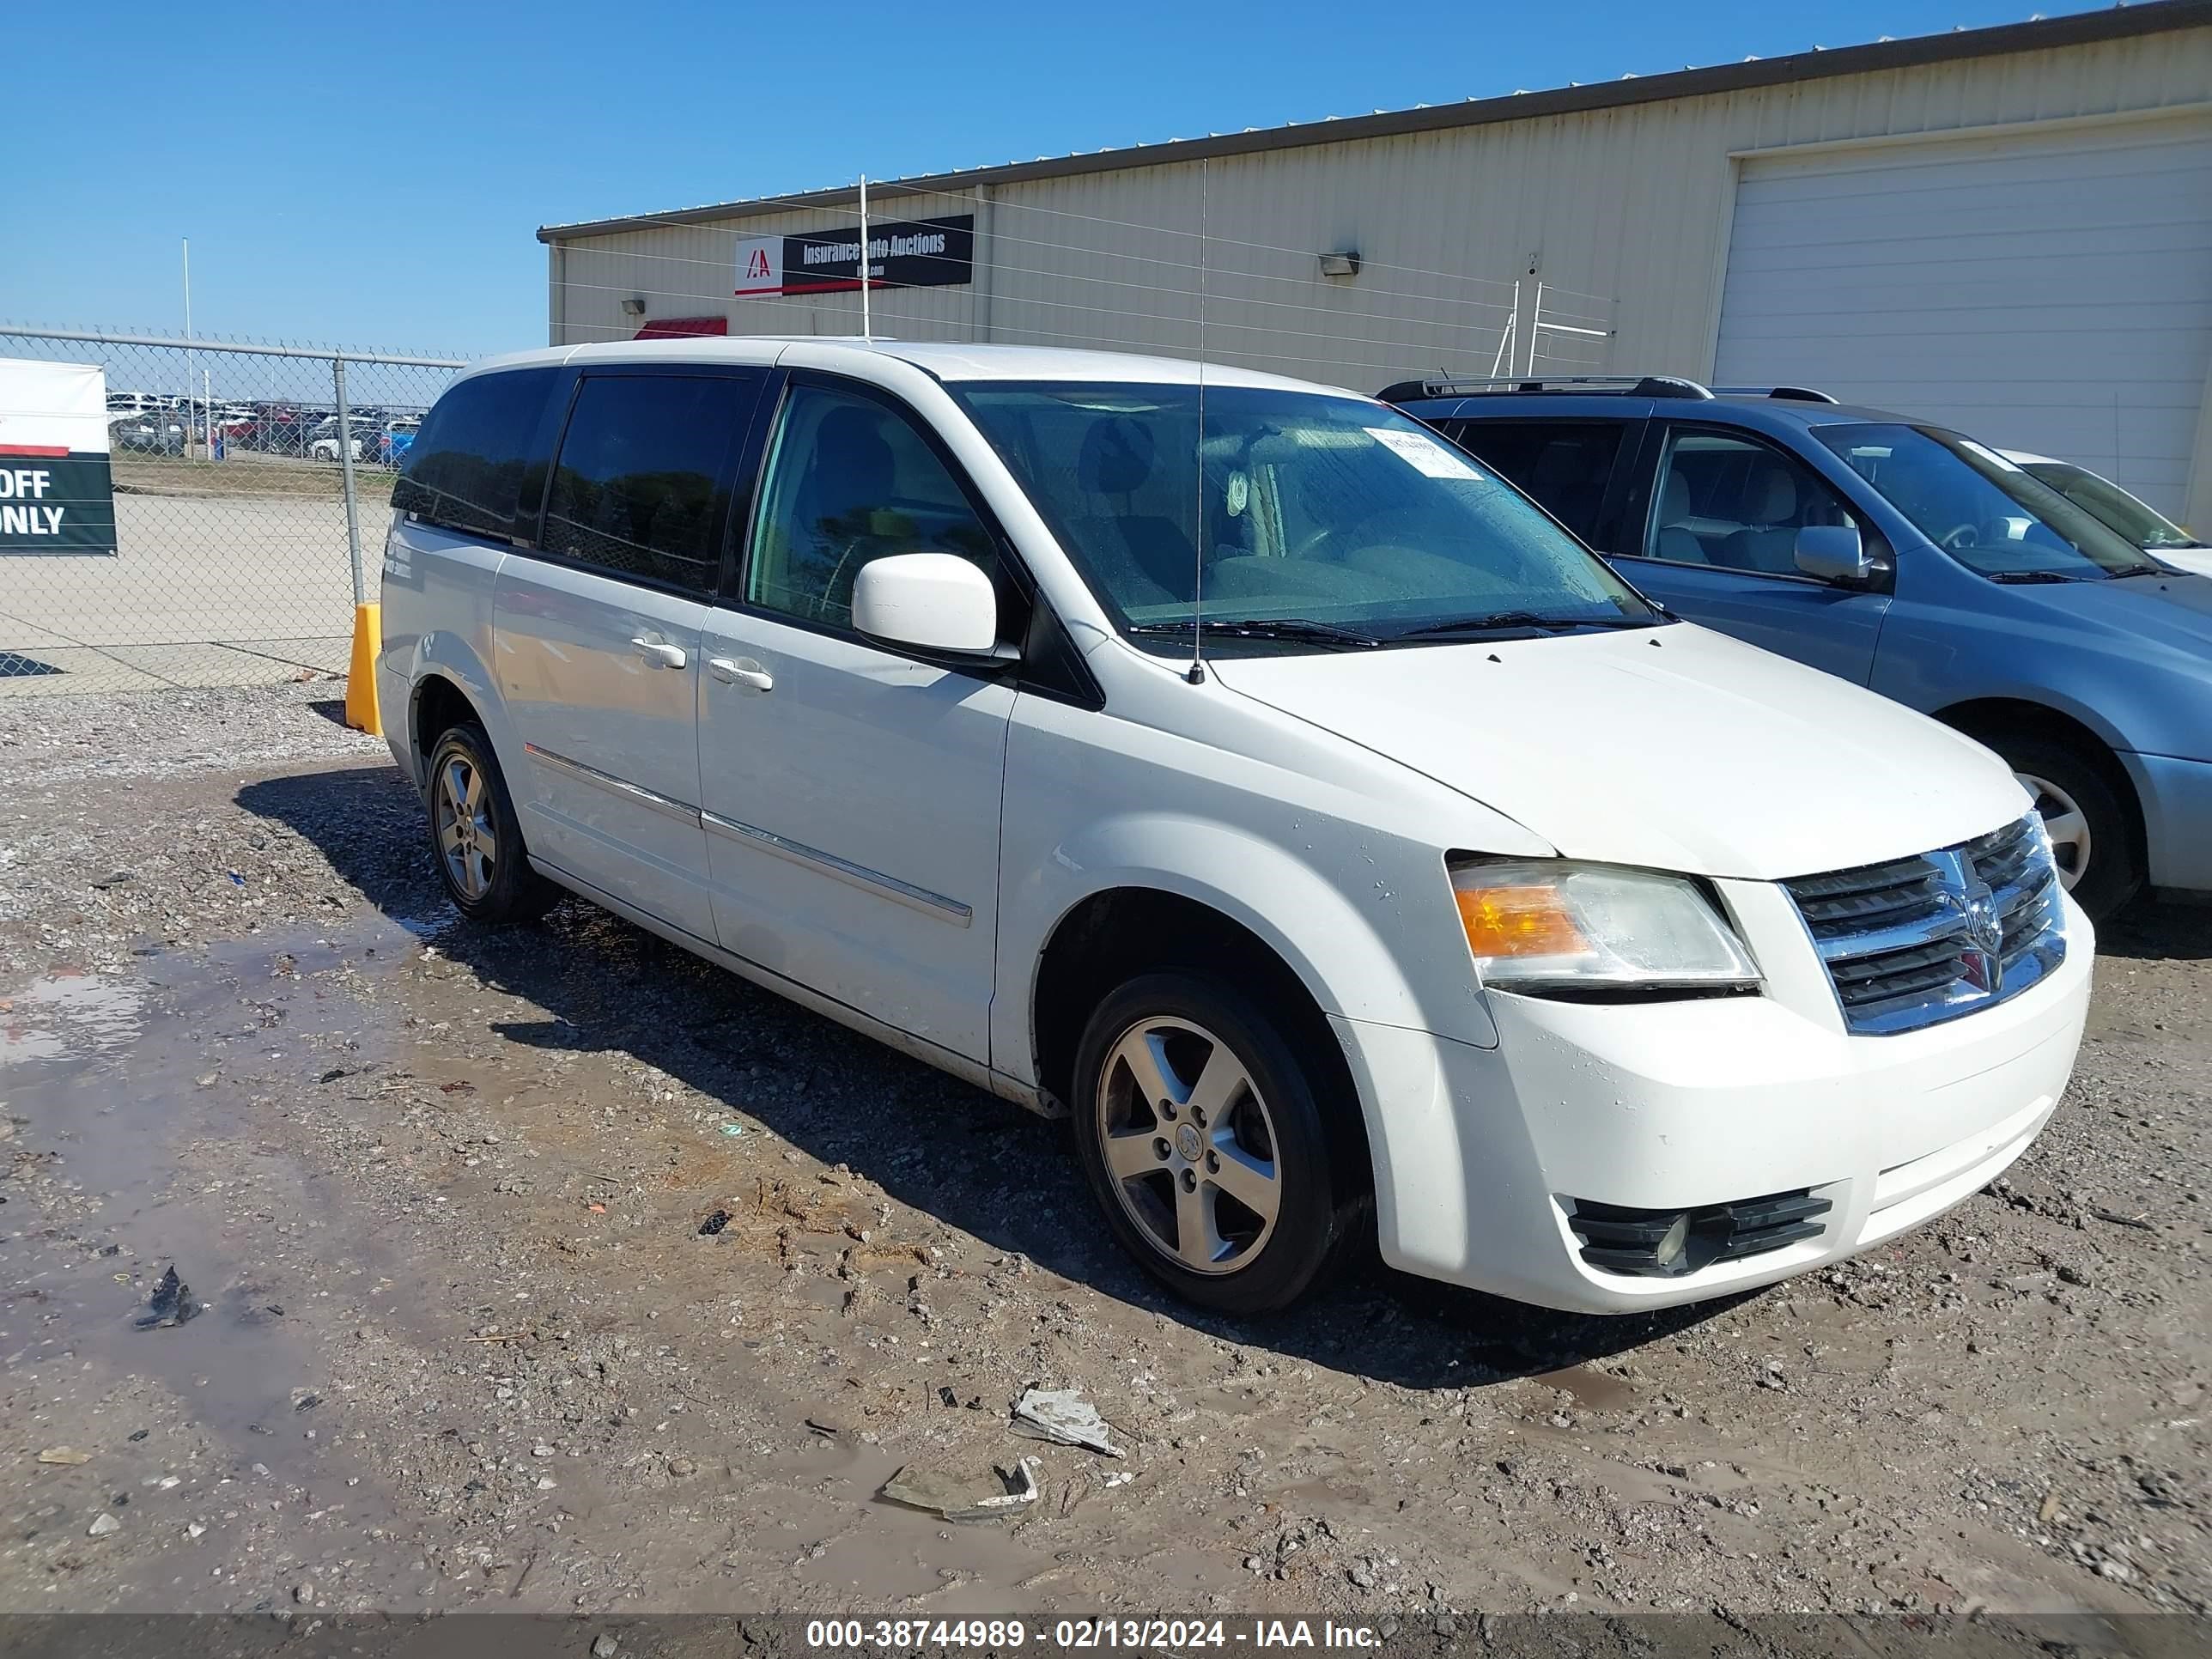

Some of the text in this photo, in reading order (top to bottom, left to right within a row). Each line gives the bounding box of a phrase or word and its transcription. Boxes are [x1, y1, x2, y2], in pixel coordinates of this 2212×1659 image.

[804, 232, 945, 265] Insurance uto Auctions
[0, 505, 65, 535] NLY
